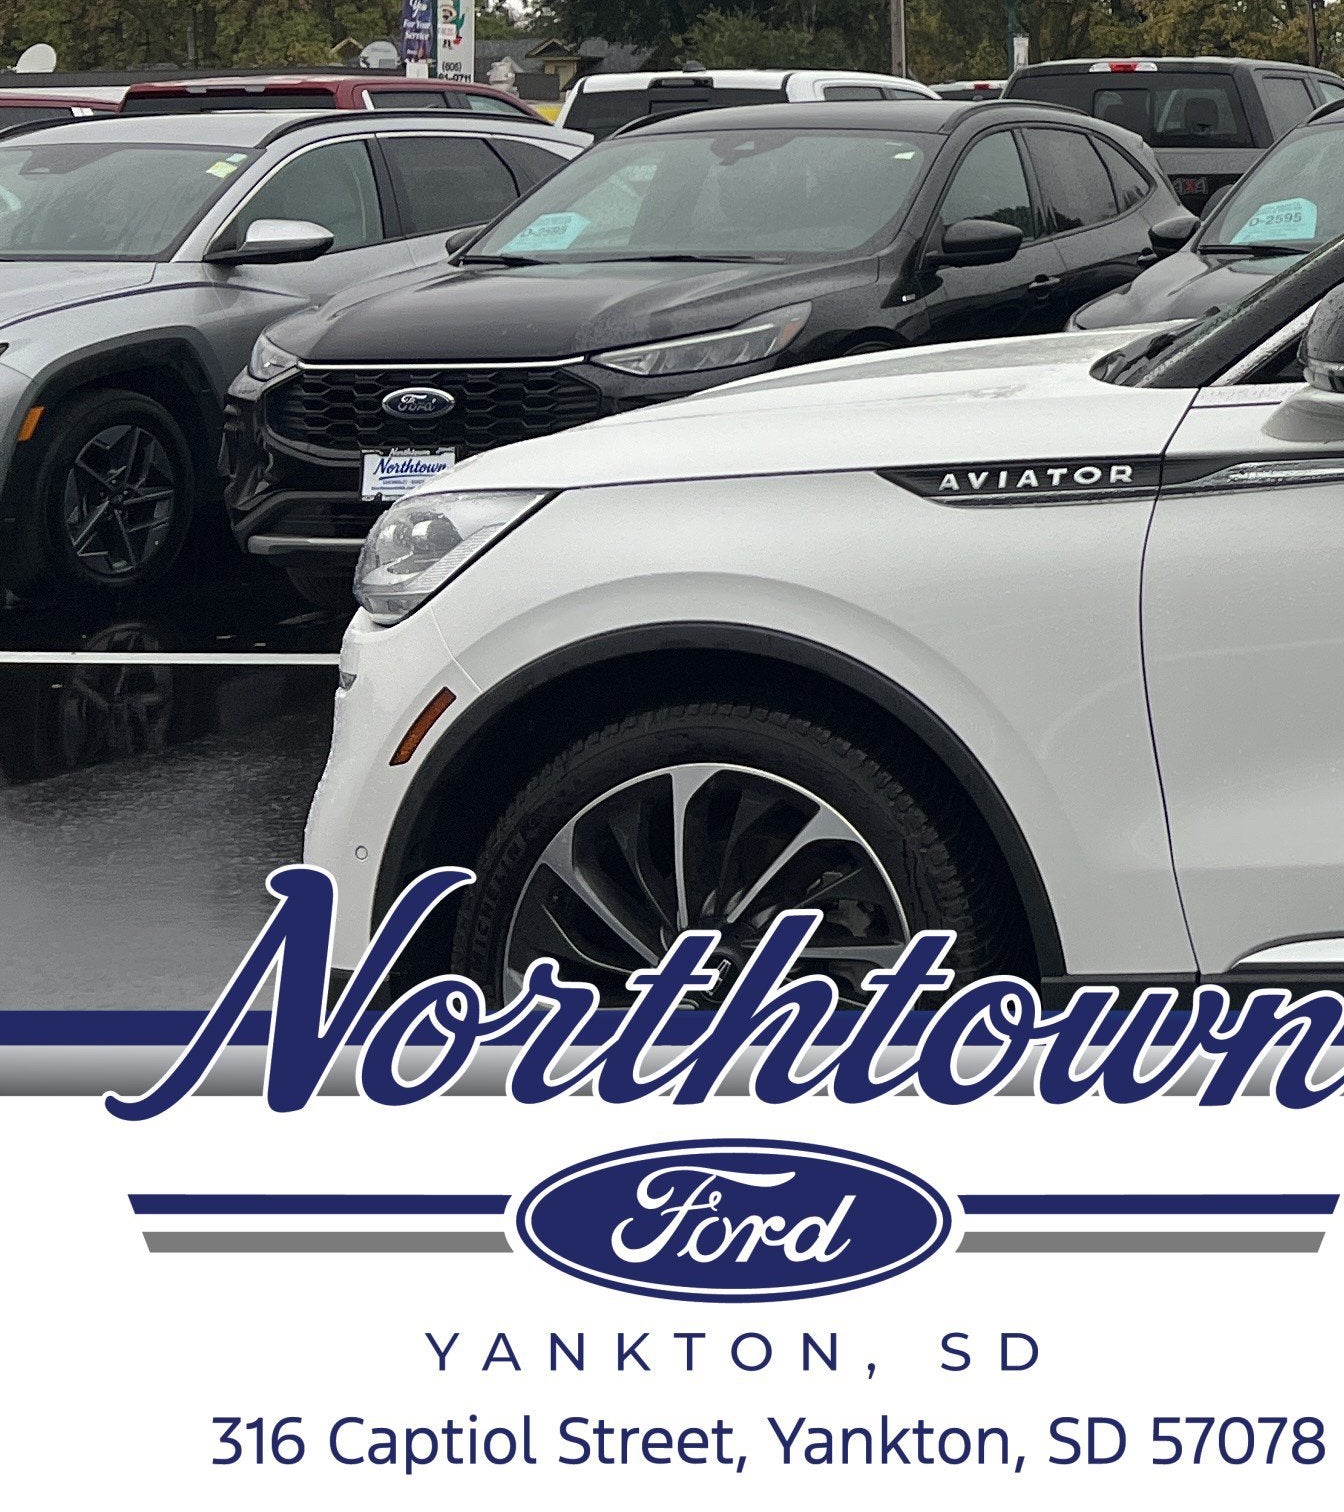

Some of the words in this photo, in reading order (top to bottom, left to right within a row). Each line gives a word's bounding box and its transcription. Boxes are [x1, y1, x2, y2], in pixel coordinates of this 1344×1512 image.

[1249, 212, 1302, 226] D-2595
[398, 394, 436, 411] Ford
[373, 458, 446, 475] Northtown
[938, 465, 1132, 491] AVIATOR
